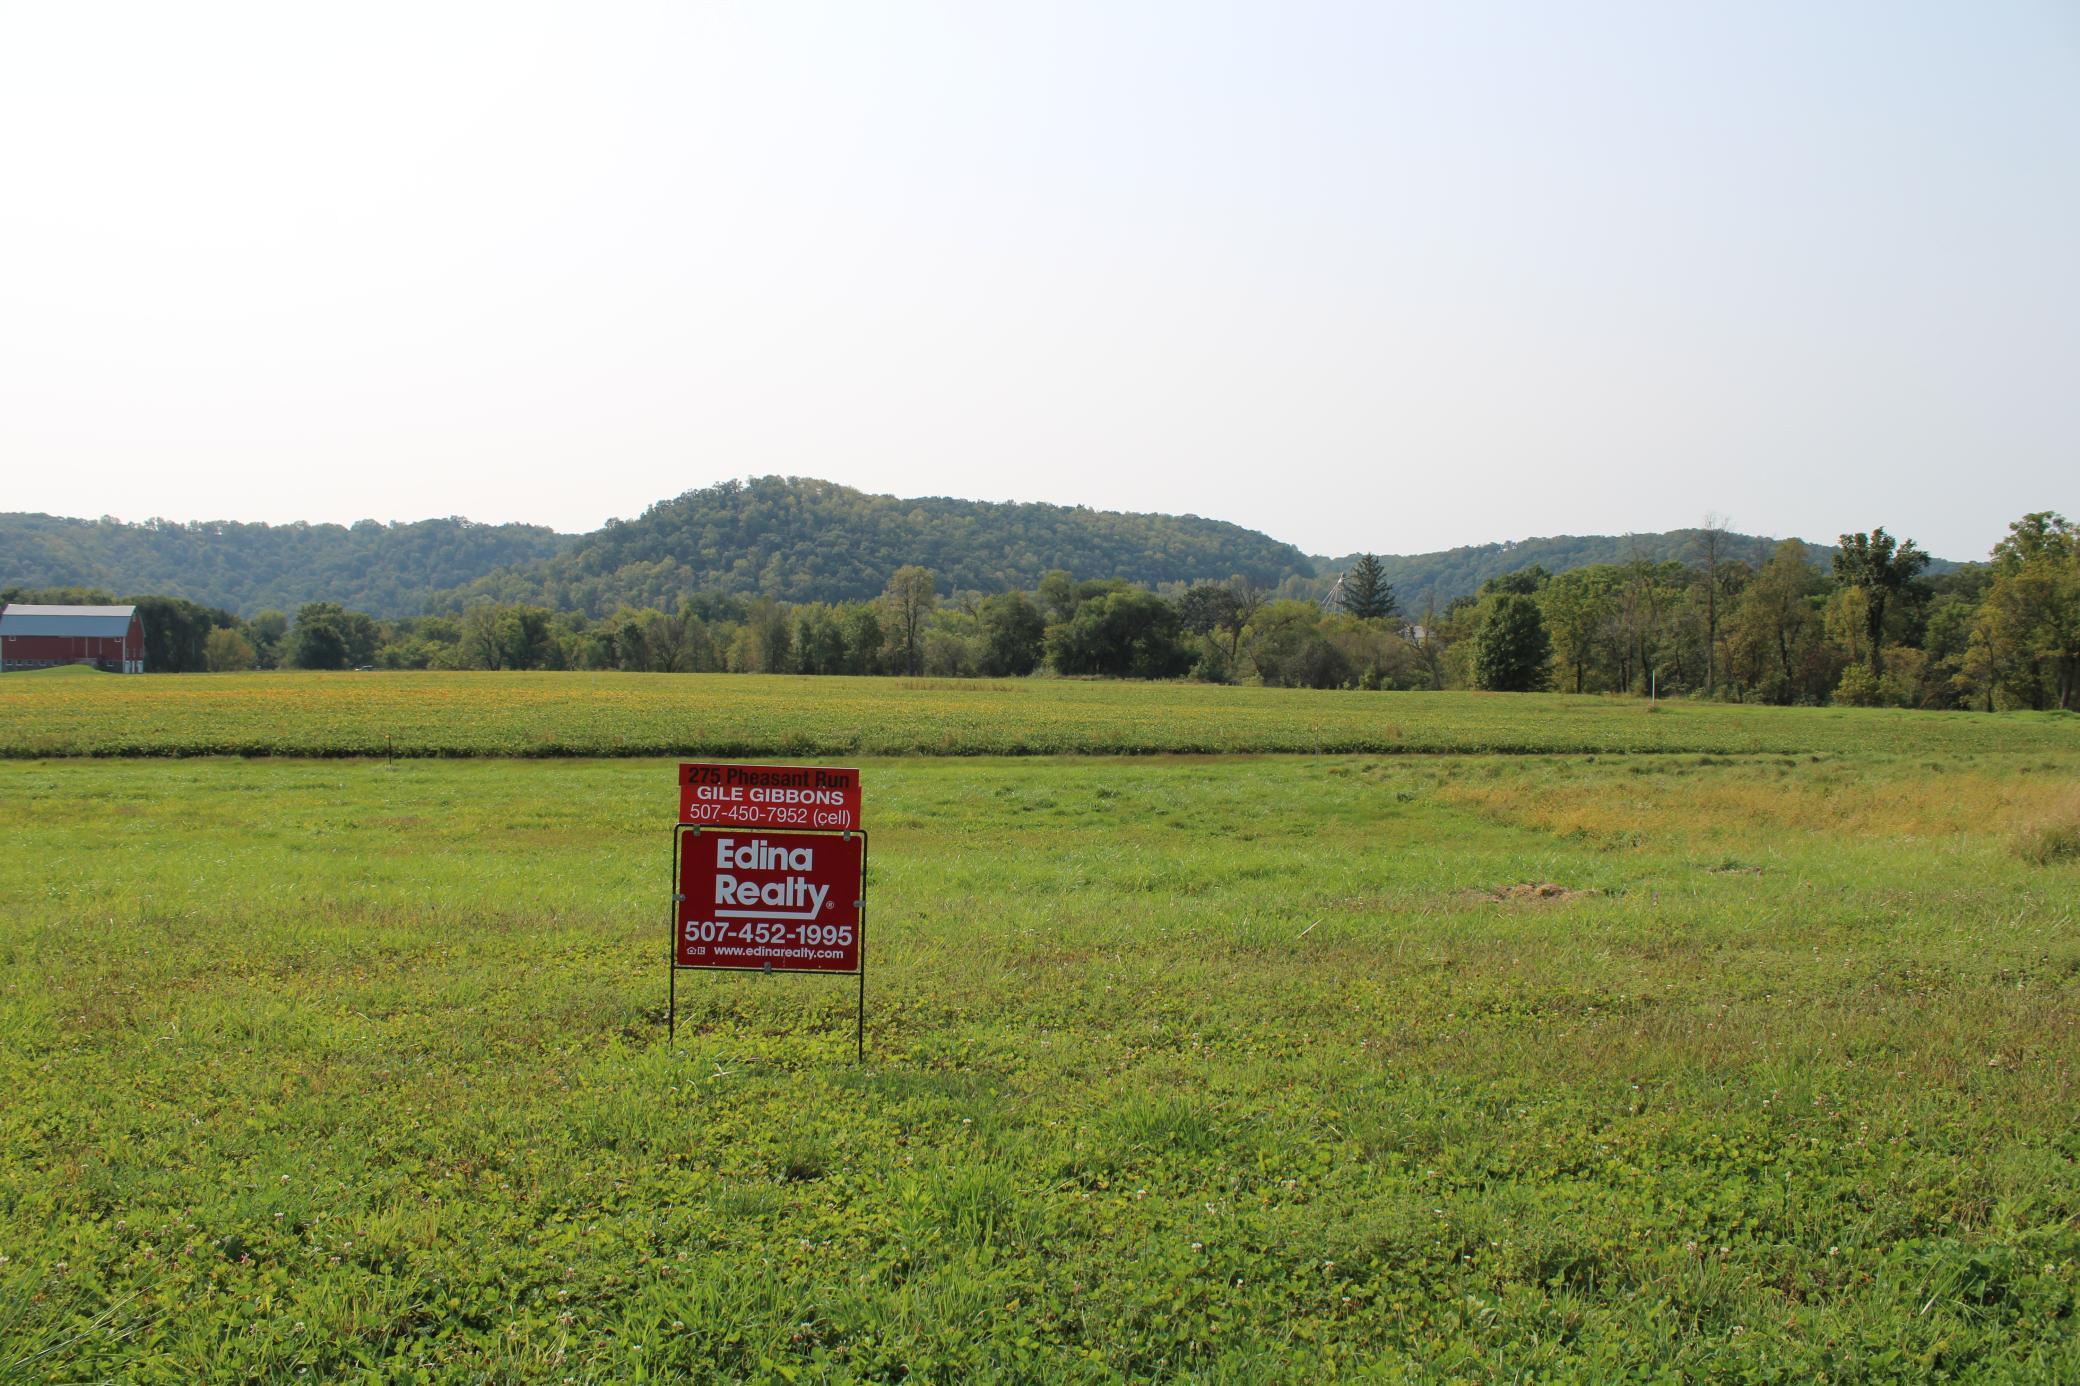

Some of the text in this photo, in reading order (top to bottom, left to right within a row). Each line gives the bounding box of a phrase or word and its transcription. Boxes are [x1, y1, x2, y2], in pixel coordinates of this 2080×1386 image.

[688, 767, 849, 788] 275 Pheasant Run
[697, 785, 844, 806] GILE GIBBONS
[690, 804, 851, 828] 507-450-7952 (cell)
[716, 838, 813, 872] Edina
[715, 874, 830, 920] Realty
[685, 921, 853, 946] 507-452-1995
[714, 946, 844, 960] www.edinarealty.com
